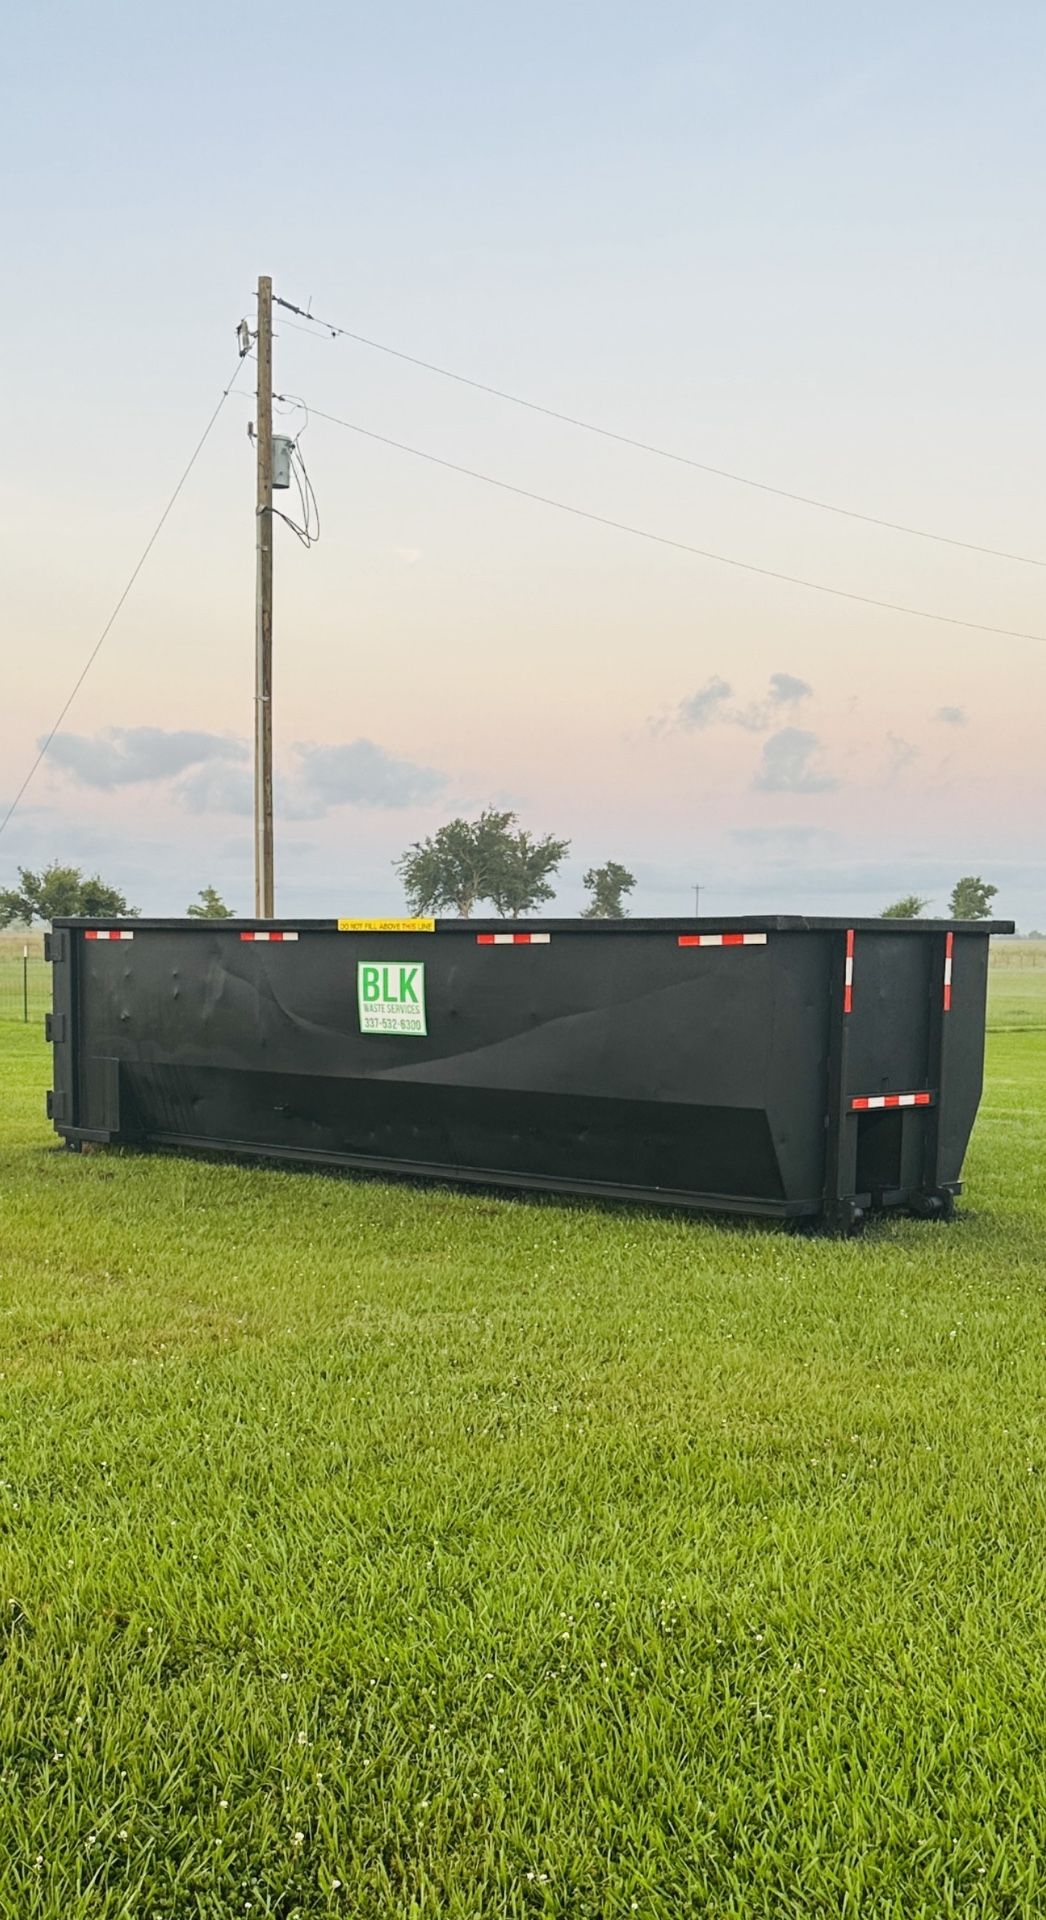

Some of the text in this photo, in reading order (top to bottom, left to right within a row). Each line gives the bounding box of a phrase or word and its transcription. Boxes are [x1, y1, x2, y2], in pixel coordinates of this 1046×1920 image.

[363, 967, 418, 1003] BLK
[364, 1003, 420, 1014] WASTE SERVICES
[364, 1017, 421, 1030] 337-532-6300
